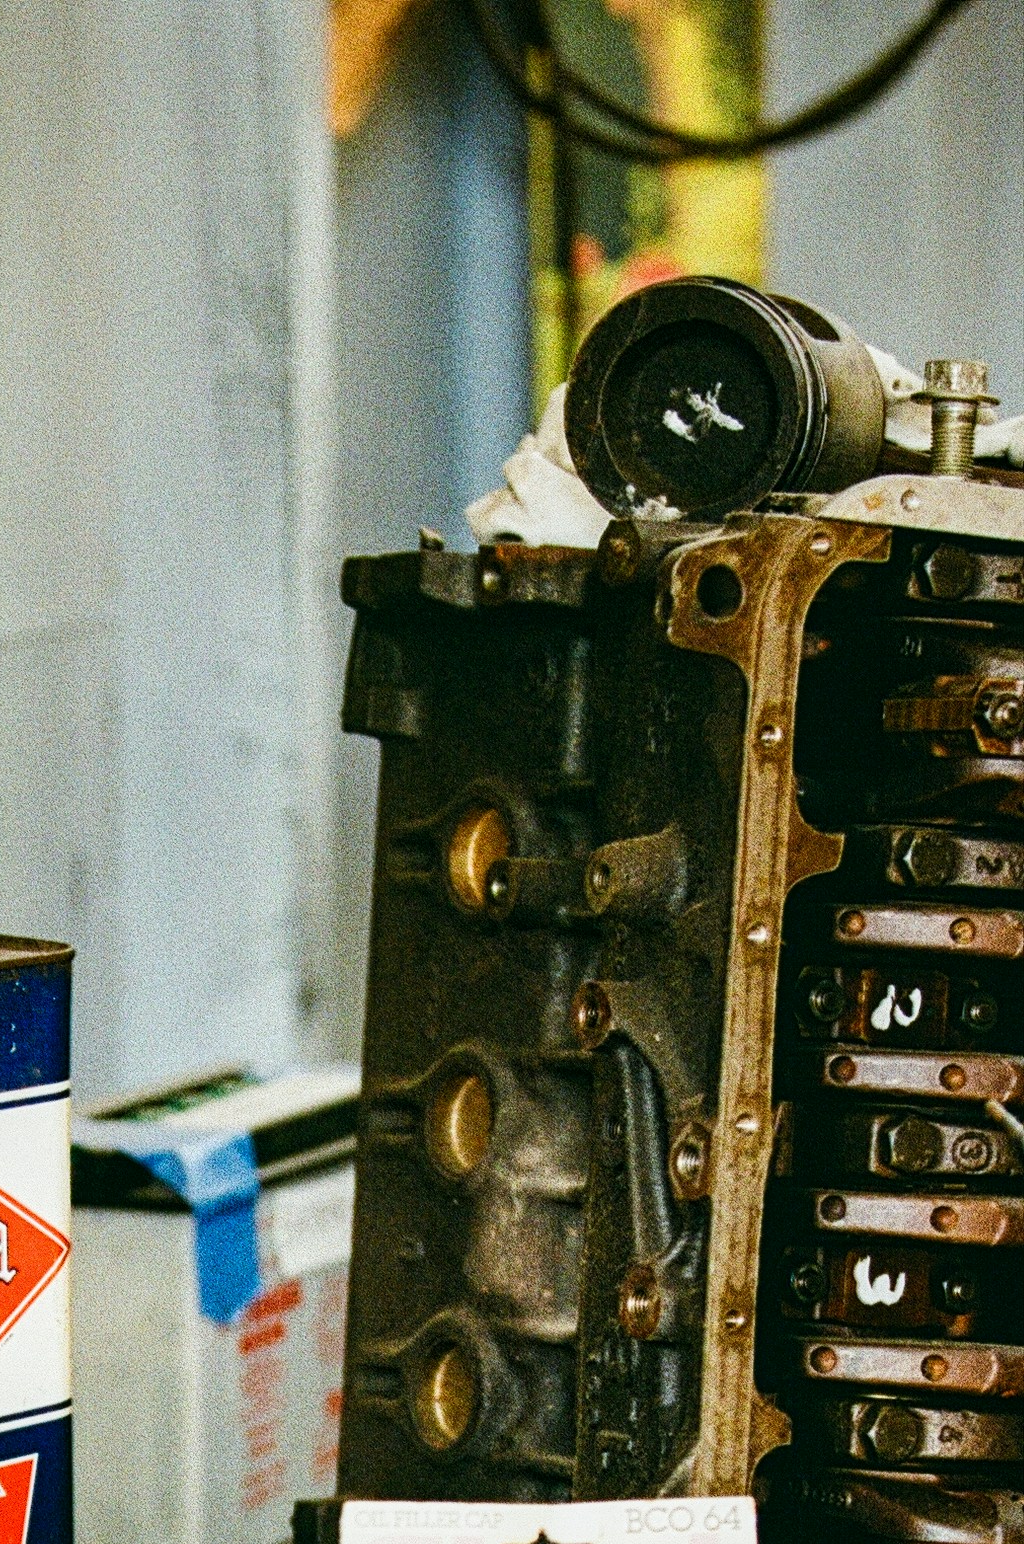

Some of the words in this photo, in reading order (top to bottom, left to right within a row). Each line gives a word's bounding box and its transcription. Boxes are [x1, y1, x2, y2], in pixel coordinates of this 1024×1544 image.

[853, 1255, 906, 1306] 3
[354, 1509, 391, 1529] OIL
[394, 1509, 461, 1529] FILLER
[464, 1510, 504, 1530] CAP
[625, 1505, 694, 1534] BCO
[702, 1504, 742, 1532] 64
